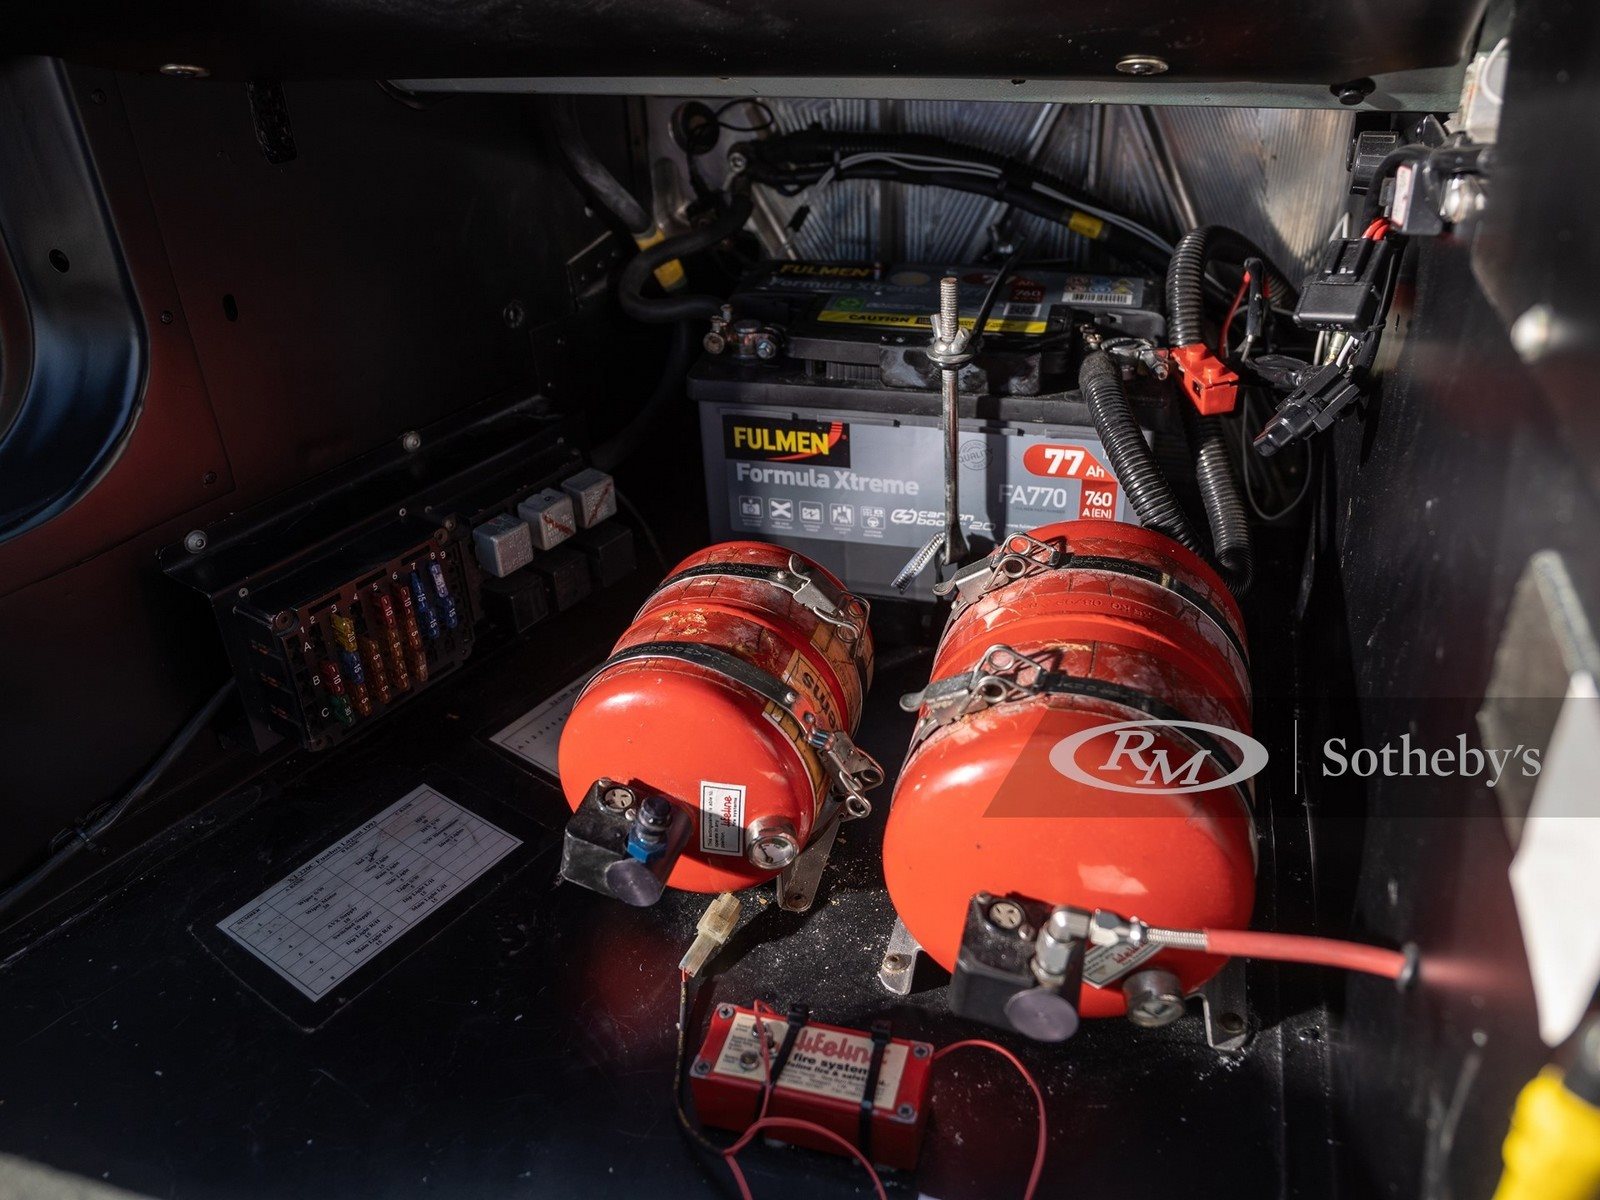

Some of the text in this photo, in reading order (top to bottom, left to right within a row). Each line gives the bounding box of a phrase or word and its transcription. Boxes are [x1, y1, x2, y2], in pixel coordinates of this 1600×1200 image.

[780, 264, 870, 277] FULMEN
[849, 314, 910, 322] CAUTION
[733, 426, 830, 455] FULMEN
[1044, 448, 1085, 476] 77
[1086, 466, 1105, 478] Ah
[736, 462, 919, 496] Formula Xtreme
[1085, 490, 1112, 507] 760
[918, 510, 974, 521] caron
[430, 552, 436, 560] 8
[440, 551, 446, 559] 9
[411, 562, 417, 570] 7
[392, 571, 398, 580] 6
[372, 583, 378, 591] 5
[353, 593, 359, 601] 4
[331, 604, 338, 613] 3
[309, 616, 316, 625] 2
[301, 626, 306, 634] 1
[303, 641, 312, 652] A
[312, 675, 321, 686] B
[321, 708, 330, 718] C
[794, 1053, 816, 1065] fire
